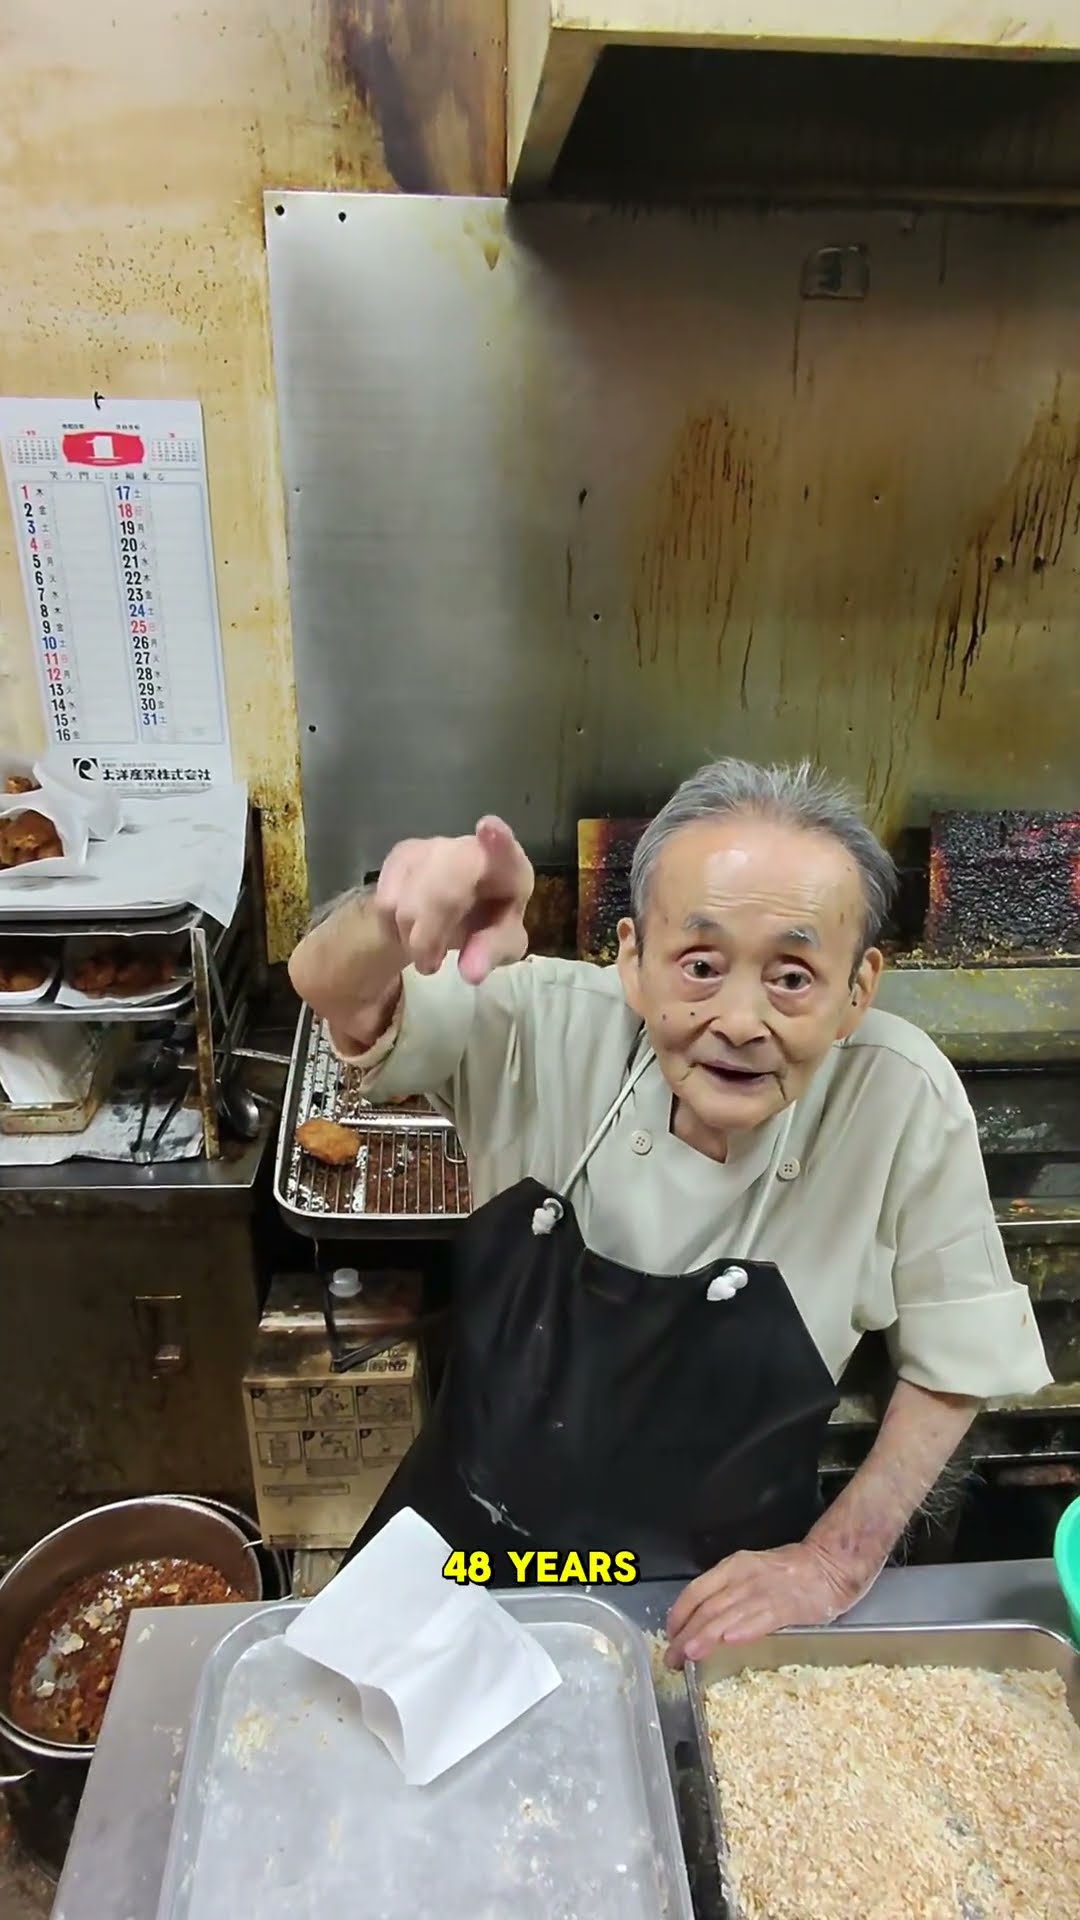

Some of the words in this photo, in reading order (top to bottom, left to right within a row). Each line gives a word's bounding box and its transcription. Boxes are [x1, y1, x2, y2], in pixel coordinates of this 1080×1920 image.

[86, 435, 122, 460] 1
[21, 485, 28, 499] 1
[116, 485, 130, 500] 17
[24, 503, 33, 517] 2
[118, 503, 132, 518] 18
[27, 520, 36, 534] 3
[120, 520, 135, 535] 19
[30, 537, 38, 552] 4
[120, 538, 138, 552] 20
[33, 554, 41, 568] 5
[122, 554, 138, 568] 21
[35, 571, 44, 585] 6
[125, 571, 142, 585] 22
[37, 587, 45, 601] 7
[127, 588, 144, 602] 23
[40, 604, 48, 617] 8
[129, 604, 145, 617] 24
[42, 620, 51, 634] 9
[131, 620, 147, 633] 25
[42, 636, 57, 650] 10
[133, 636, 149, 649] 26
[44, 652, 58, 665] 11
[134, 652, 150, 665] 27
[47, 667, 61, 681] 12
[136, 667, 153, 680] 28
[49, 683, 64, 696] 13
[138, 682, 154, 695] 29
[52, 699, 66, 712] 14
[141, 698, 156, 711] 30
[54, 713, 68, 727] 15
[143, 713, 157, 726] 31
[56, 728, 71, 741] 16
